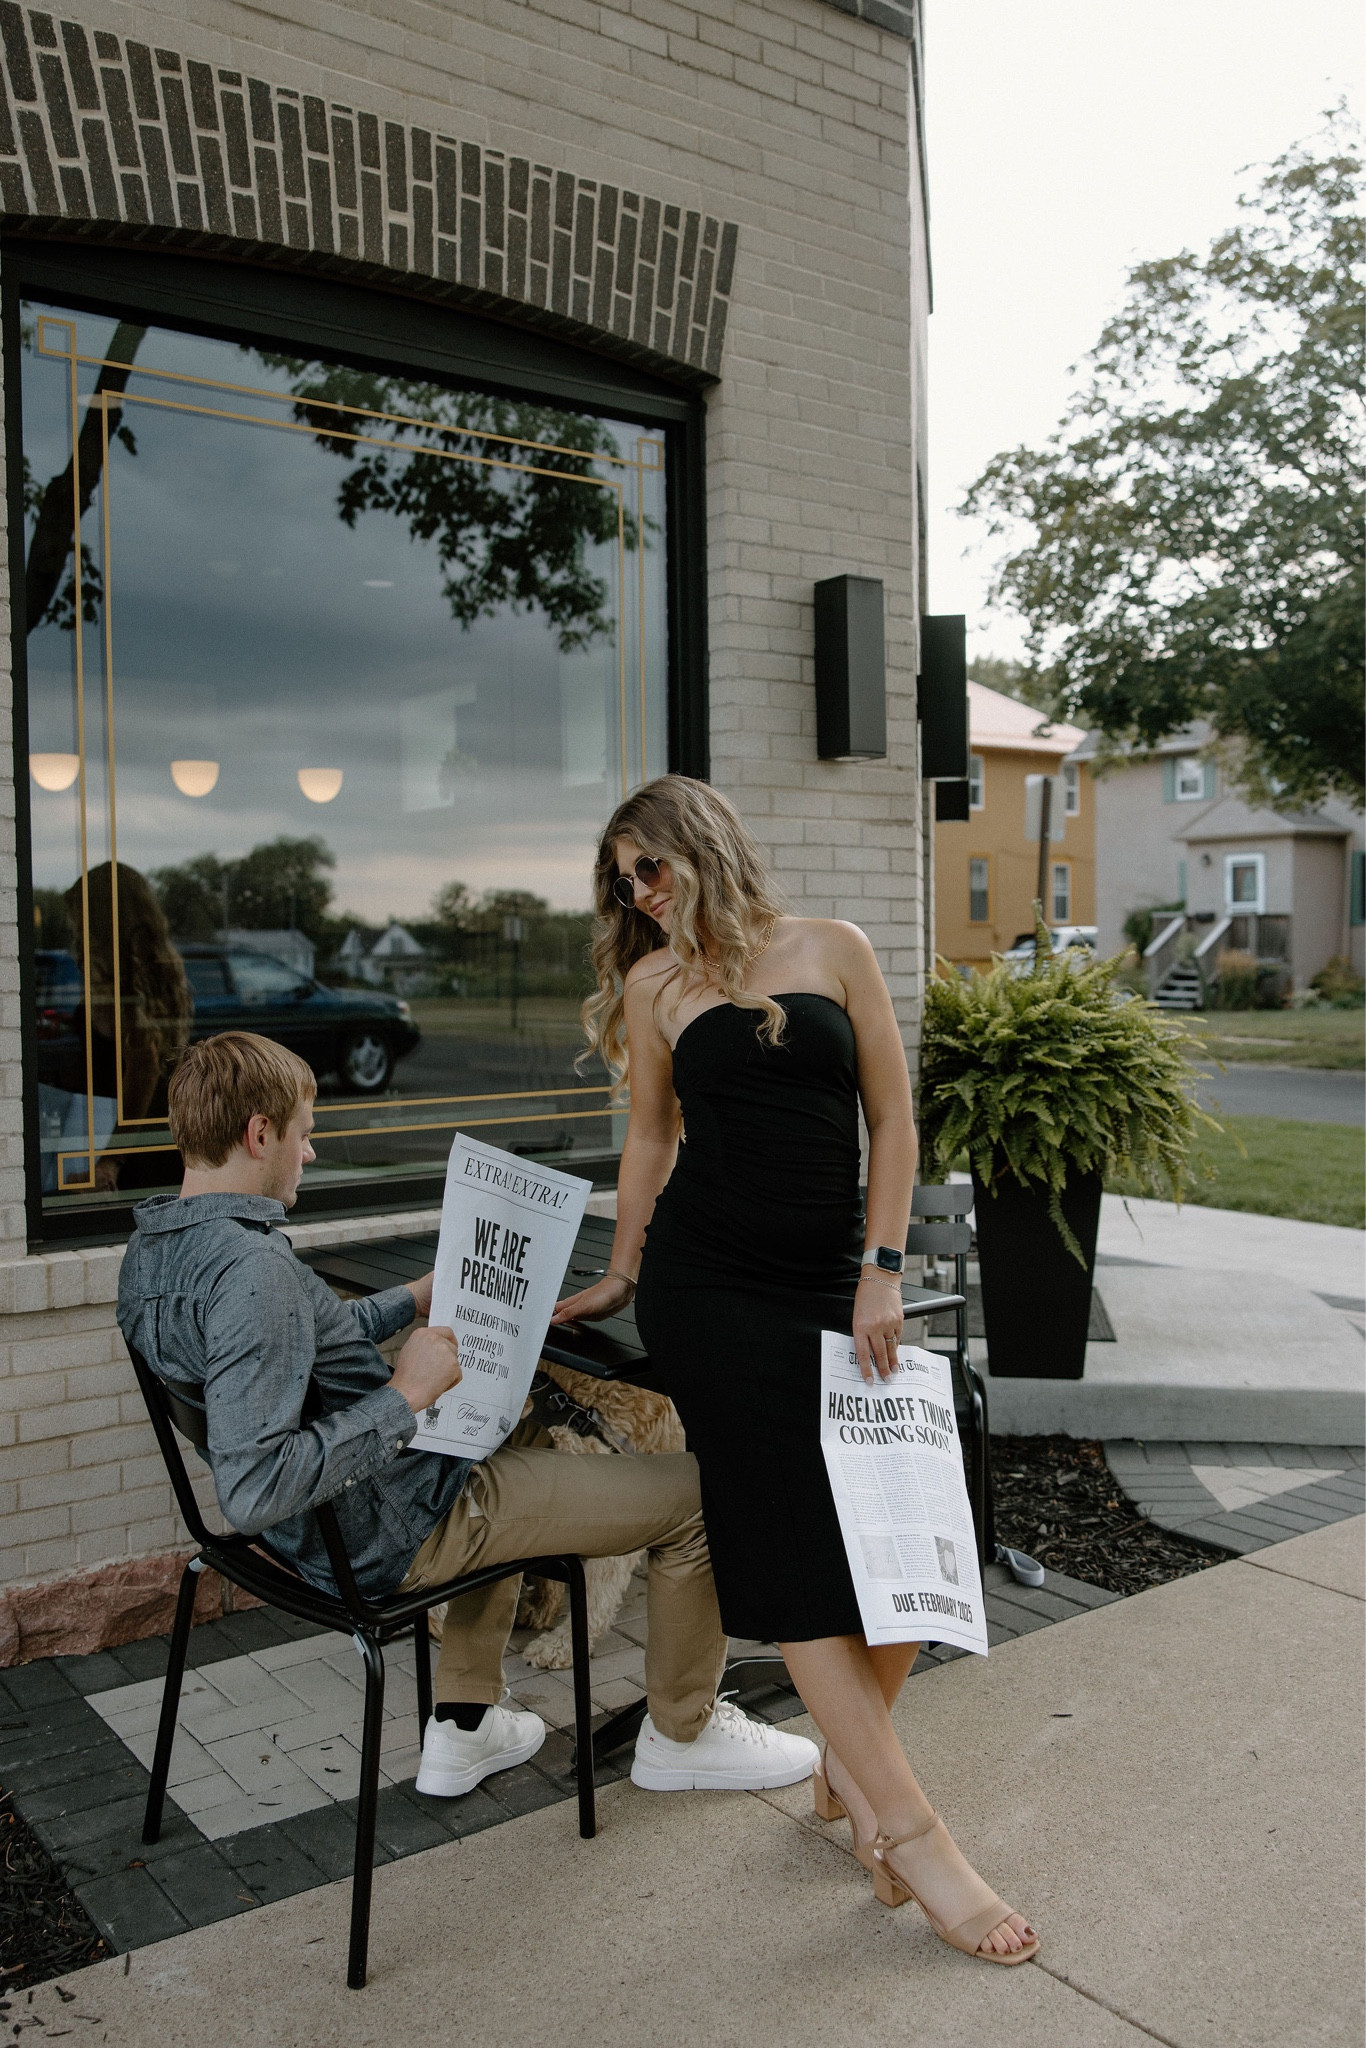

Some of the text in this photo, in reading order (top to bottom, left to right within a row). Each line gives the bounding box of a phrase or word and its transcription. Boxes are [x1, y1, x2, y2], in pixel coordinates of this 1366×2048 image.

[464, 1157, 569, 1209] EXTRA! EXTRA!
[475, 1217, 532, 1274] WE ARE
[460, 1257, 530, 1310] PREGNANT!
[455, 1305, 520, 1338] HASELHOFF TWINS
[462, 1333, 498, 1359] coming
[476, 1358, 498, 1375] near
[905, 1359, 930, 1375] Times
[457, 1402, 491, 1430] February
[828, 1391, 954, 1434] HASELHOFF TWINS
[839, 1424, 952, 1454] COMING SOON!
[891, 1593, 919, 1613] DUE
[917, 1592, 958, 1618] FEBRUARY
